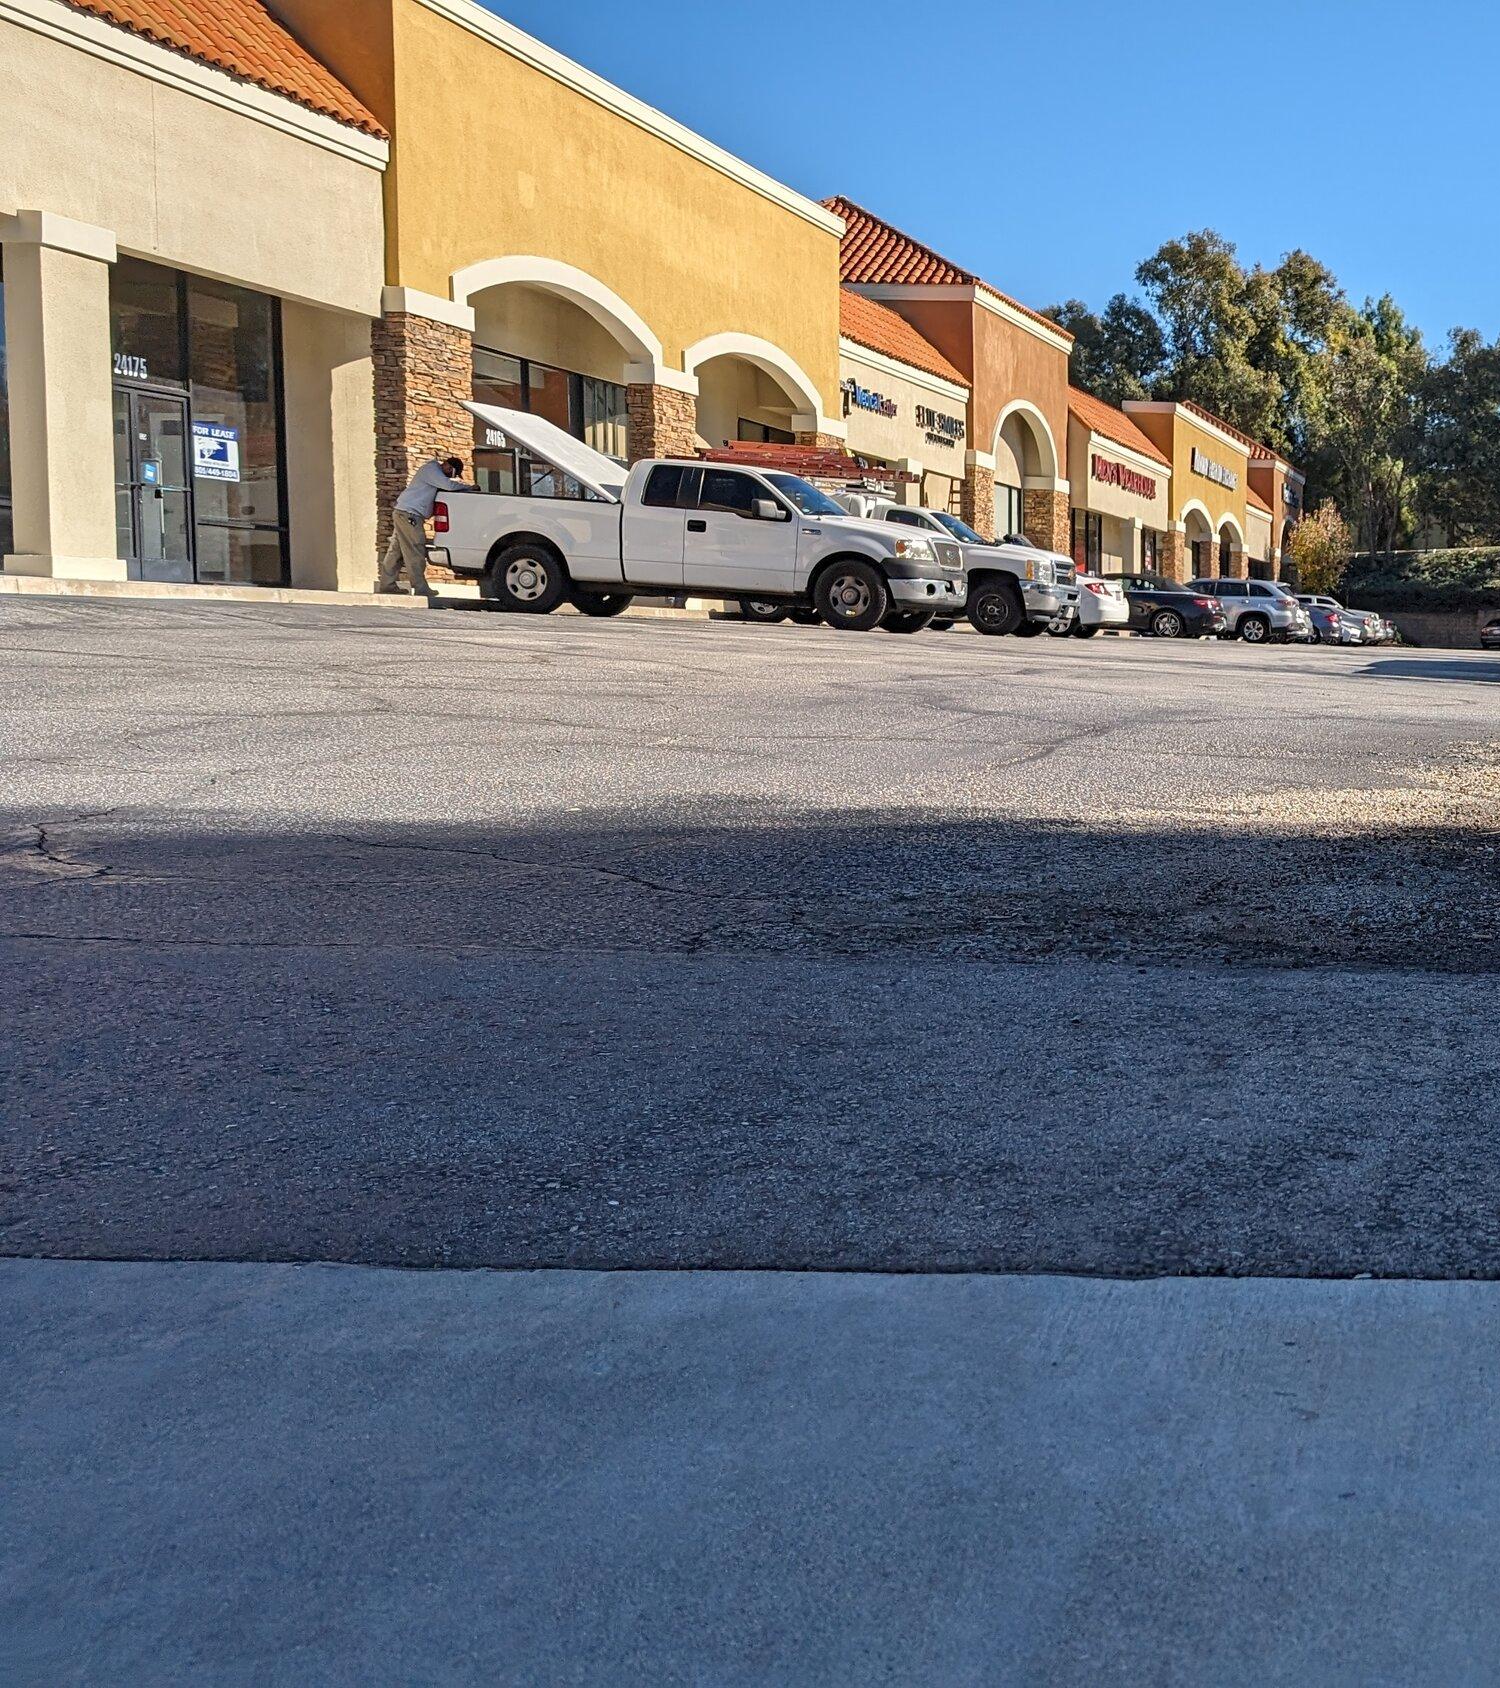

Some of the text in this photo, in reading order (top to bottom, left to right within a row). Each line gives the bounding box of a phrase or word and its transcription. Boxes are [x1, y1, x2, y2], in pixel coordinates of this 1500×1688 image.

[114, 353, 148, 379] 24175
[192, 425, 235, 439] FOR LEASE
